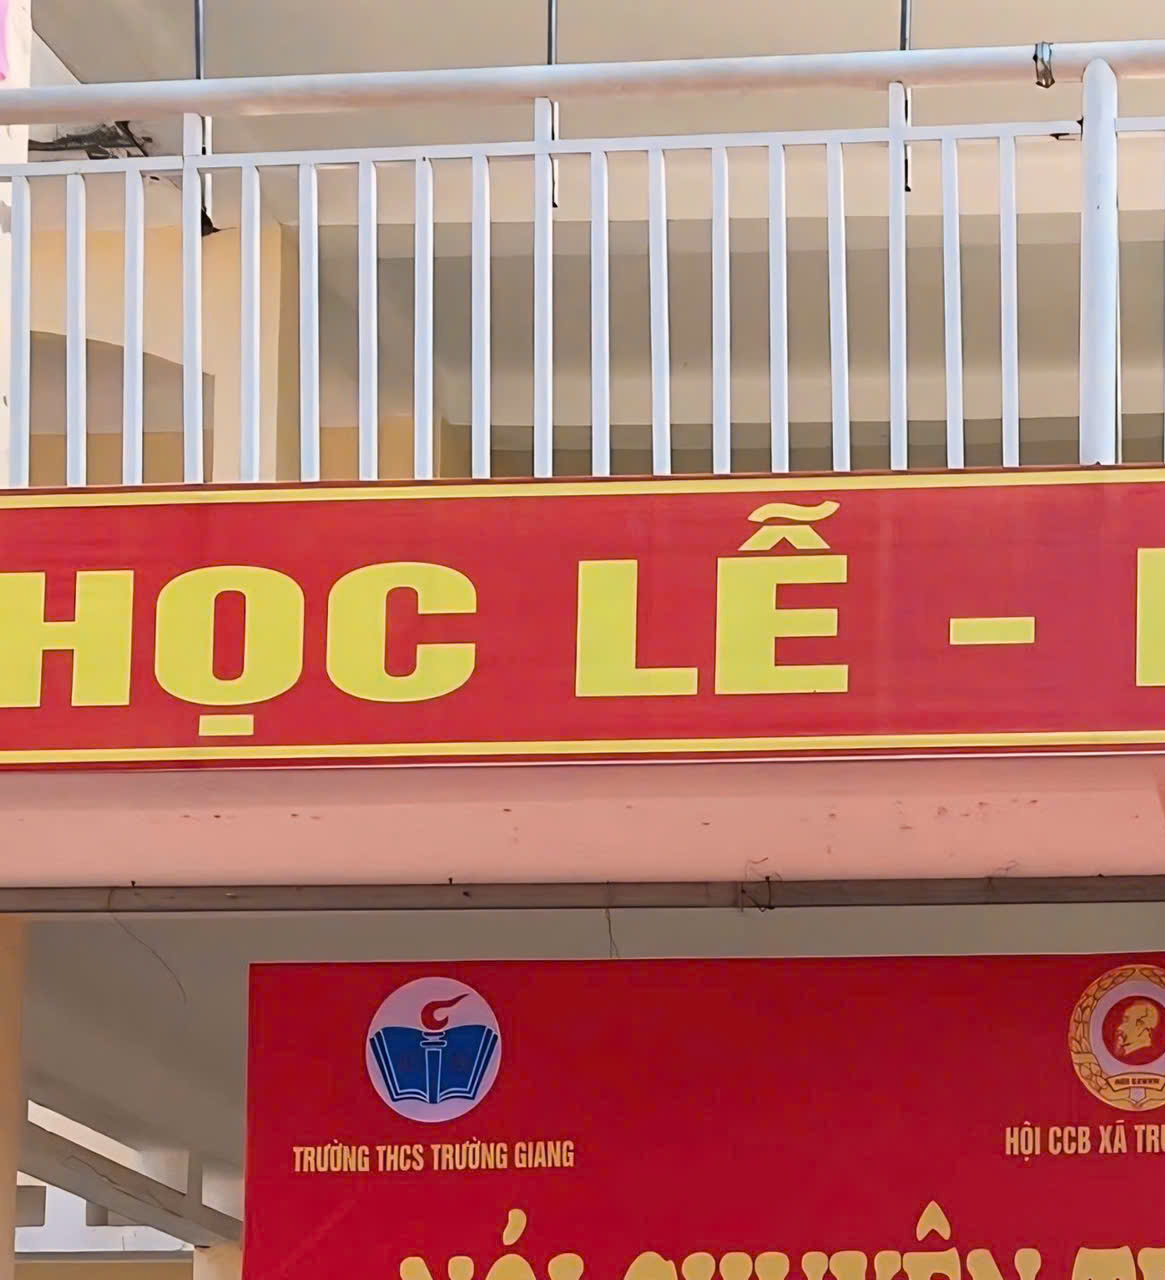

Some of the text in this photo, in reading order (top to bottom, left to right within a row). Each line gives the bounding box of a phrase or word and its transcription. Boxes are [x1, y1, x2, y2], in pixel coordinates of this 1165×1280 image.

[0, 561, 477, 737] HỌC
[575, 500, 848, 697] LỄ
[950, 616, 1035, 645] -
[293, 1136, 574, 1172] TRƯỜNG THCS TRƯỜNG GIANG
[1005, 1121, 1041, 1162] HỘI
[1049, 1126, 1091, 1154] CCB
[1099, 1119, 1127, 1154] XÃ
